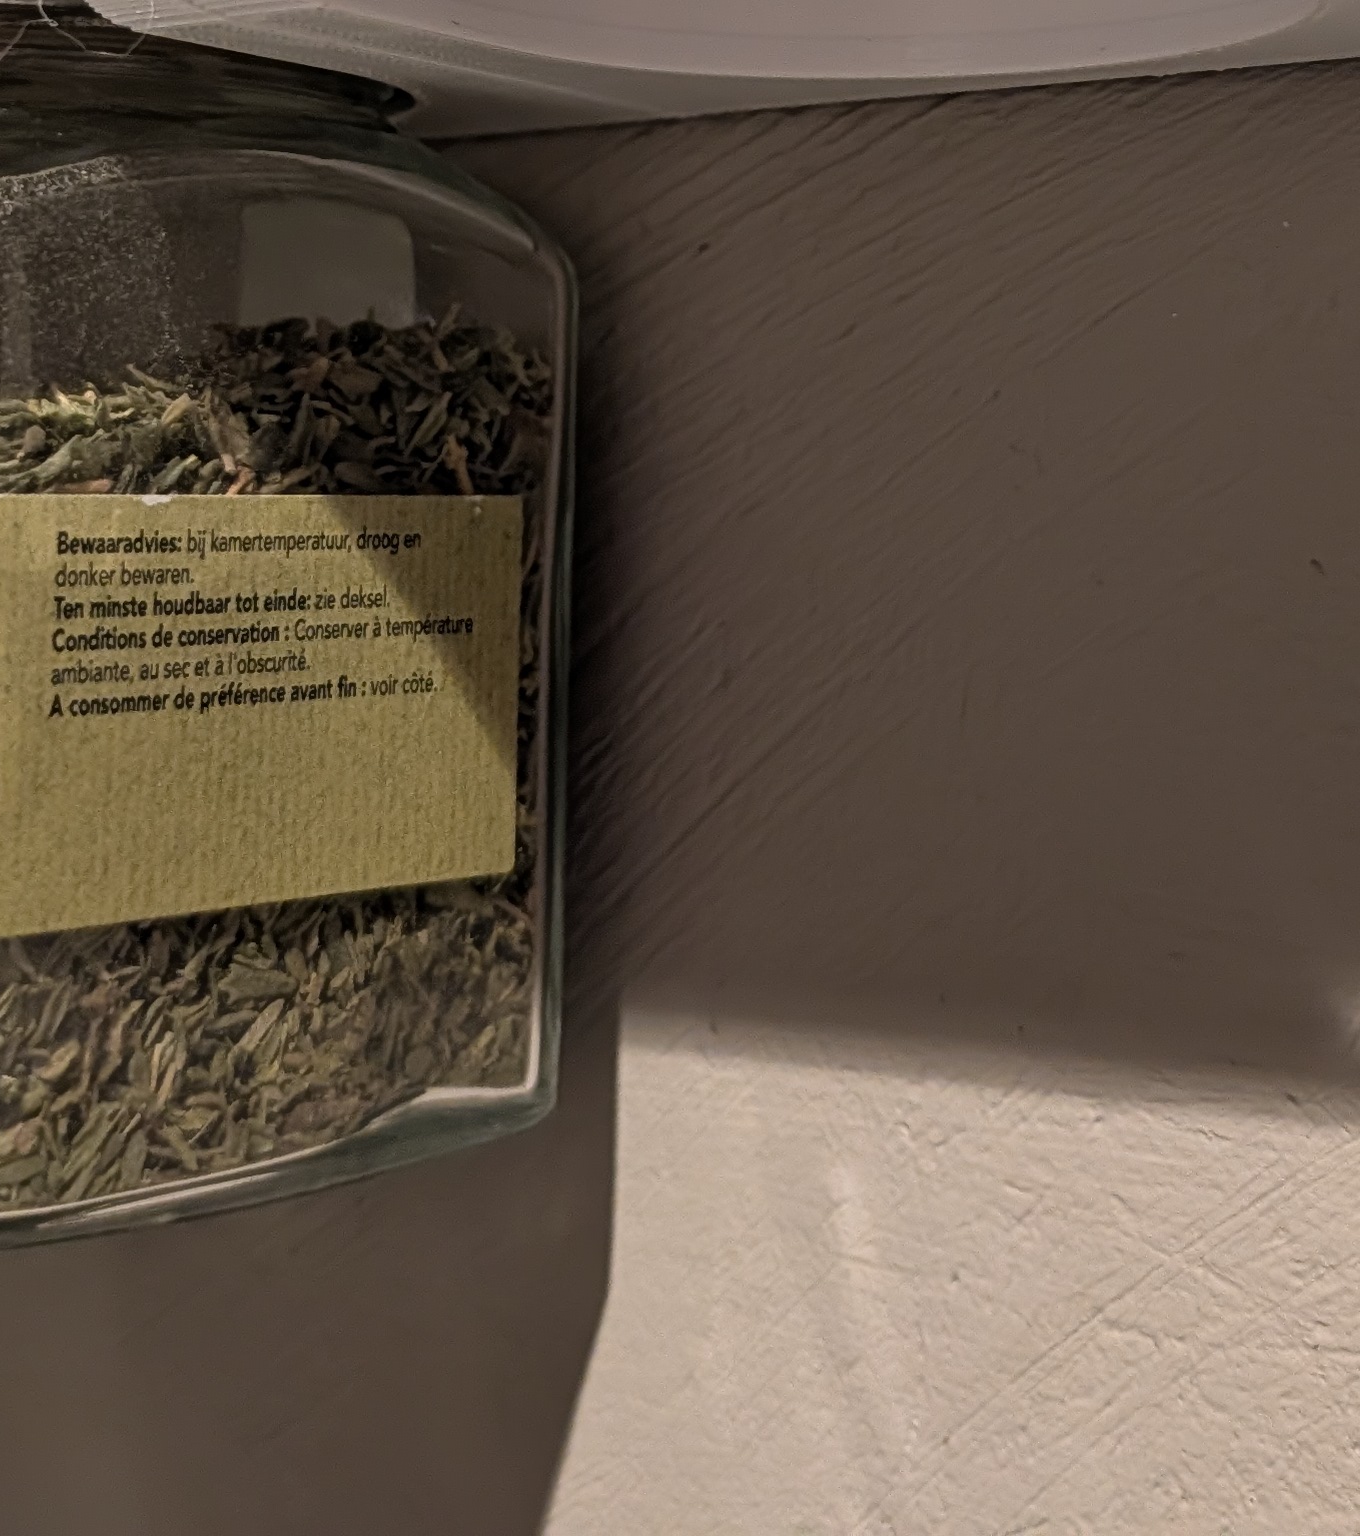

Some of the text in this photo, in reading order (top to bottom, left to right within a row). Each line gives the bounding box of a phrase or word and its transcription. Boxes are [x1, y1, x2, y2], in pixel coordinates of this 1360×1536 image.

[56, 526, 421, 559] Bewaaradvies: bij kamertemperatuur, droog en
[55, 562, 195, 588] donker bewaren.
[53, 584, 390, 619] Ten minste houdbaar tot einde: zie deksel.
[52, 625, 147, 653] Conditions
[152, 624, 173, 647] de
[178, 622, 280, 646] conservation
[294, 618, 369, 641] Conserver
[372, 616, 382, 638] à
[386, 613, 473, 642] température
[51, 647, 311, 685] ambiante, au sec et à l'obscurité.
[48, 694, 63, 717] A
[70, 692, 170, 717] consommer
[174, 685, 194, 709] de
[200, 681, 286, 714] préférence
[290, 679, 333, 701] avant
[338, 675, 357, 696] fin
[370, 674, 399, 695] voir
[403, 670, 438, 693] côté.
